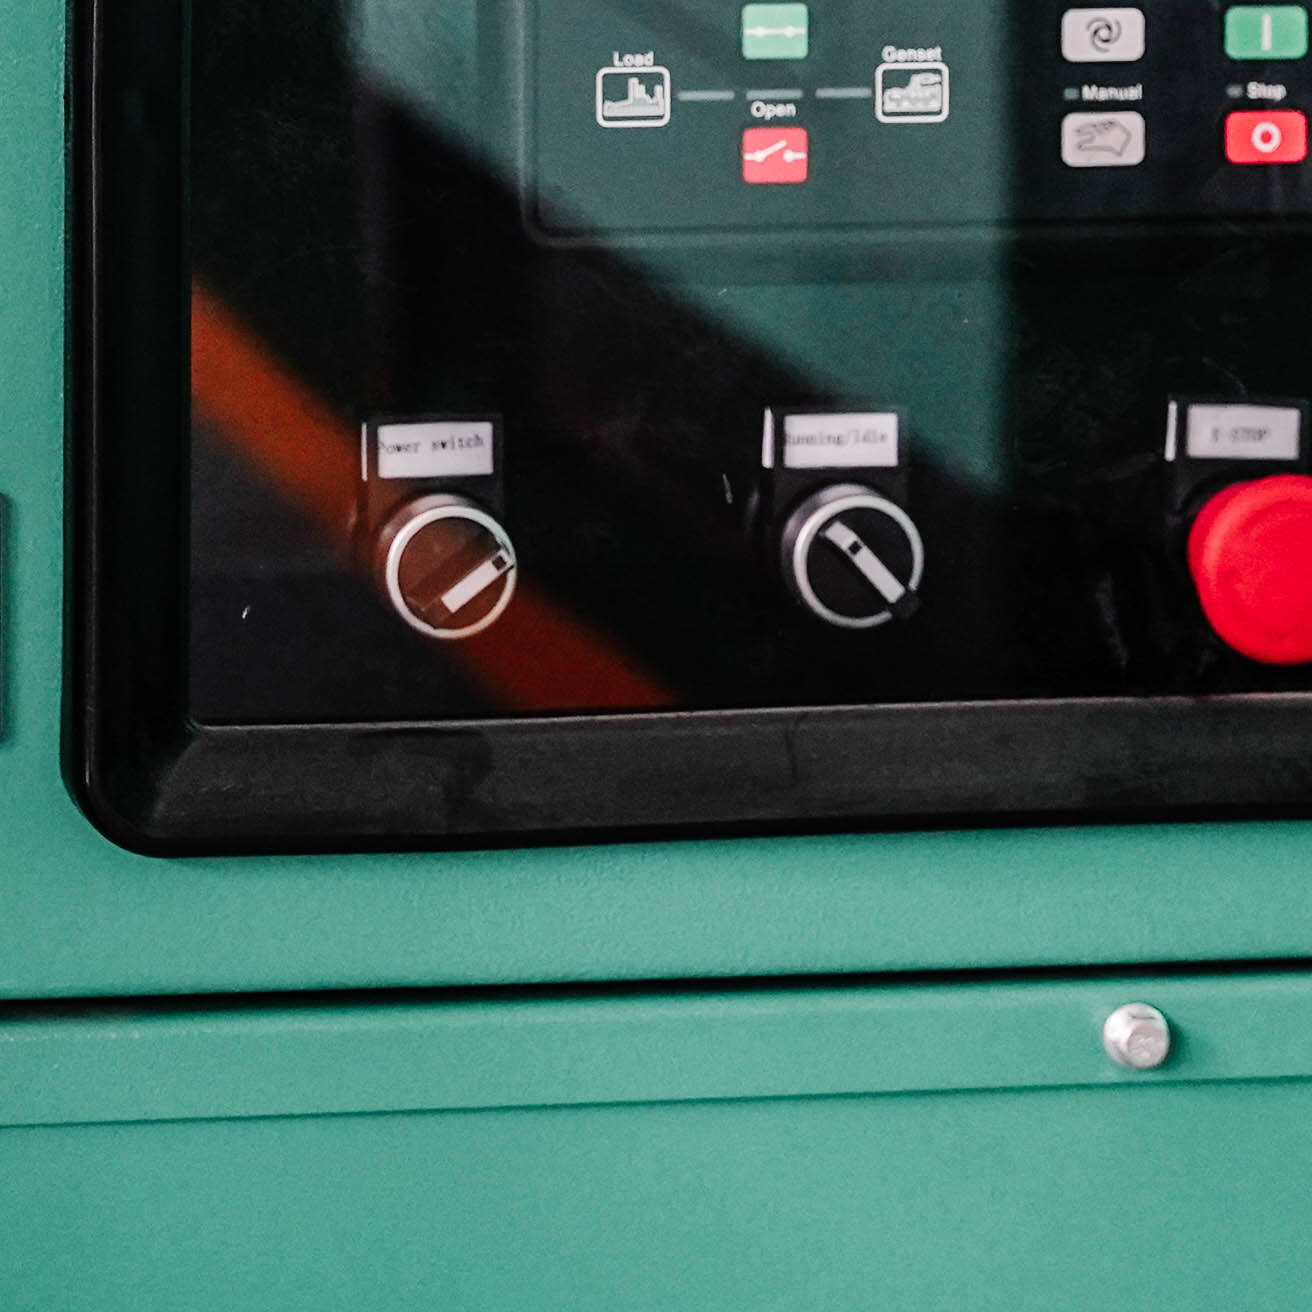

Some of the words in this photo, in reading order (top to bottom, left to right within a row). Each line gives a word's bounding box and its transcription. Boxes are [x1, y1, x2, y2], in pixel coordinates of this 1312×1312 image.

[613, 51, 654, 67] Load
[881, 45, 942, 62] Genset
[1081, 83, 1143, 101] Manual
[1246, 81, 1287, 102] Stop
[750, 100, 796, 120] Open
[431, 434, 484, 451] switch
